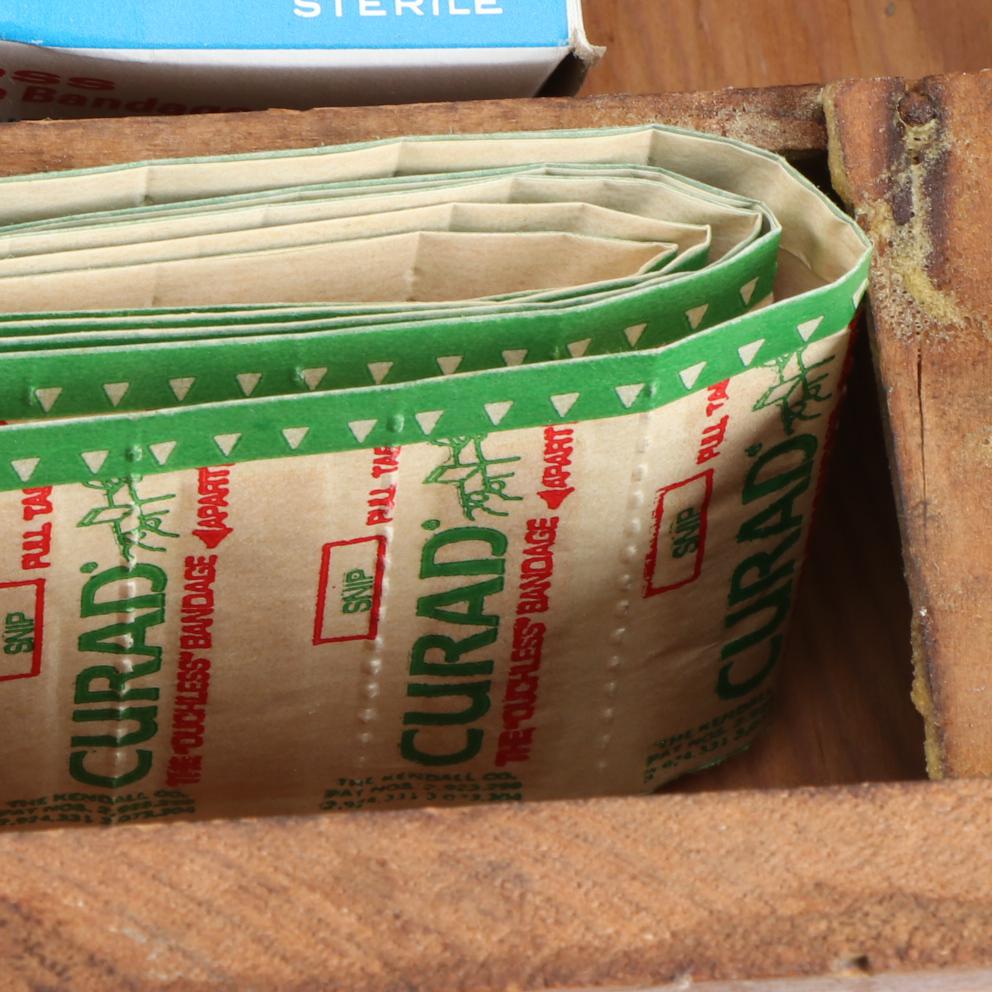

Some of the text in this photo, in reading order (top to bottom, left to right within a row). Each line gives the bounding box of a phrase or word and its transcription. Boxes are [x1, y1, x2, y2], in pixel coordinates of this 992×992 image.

[21, 522, 53, 570] PULL
[366, 485, 397, 526] PULL
[180, 554, 218, 650] BANDAGE
[342, 568, 374, 614] SNIP
[516, 516, 560, 615] BANDAGE
[715, 434, 819, 701] CURAD
[4, 611, 35, 655] SNIP
[69, 563, 168, 788] CURAD
[400, 526, 509, 767] CURAD
